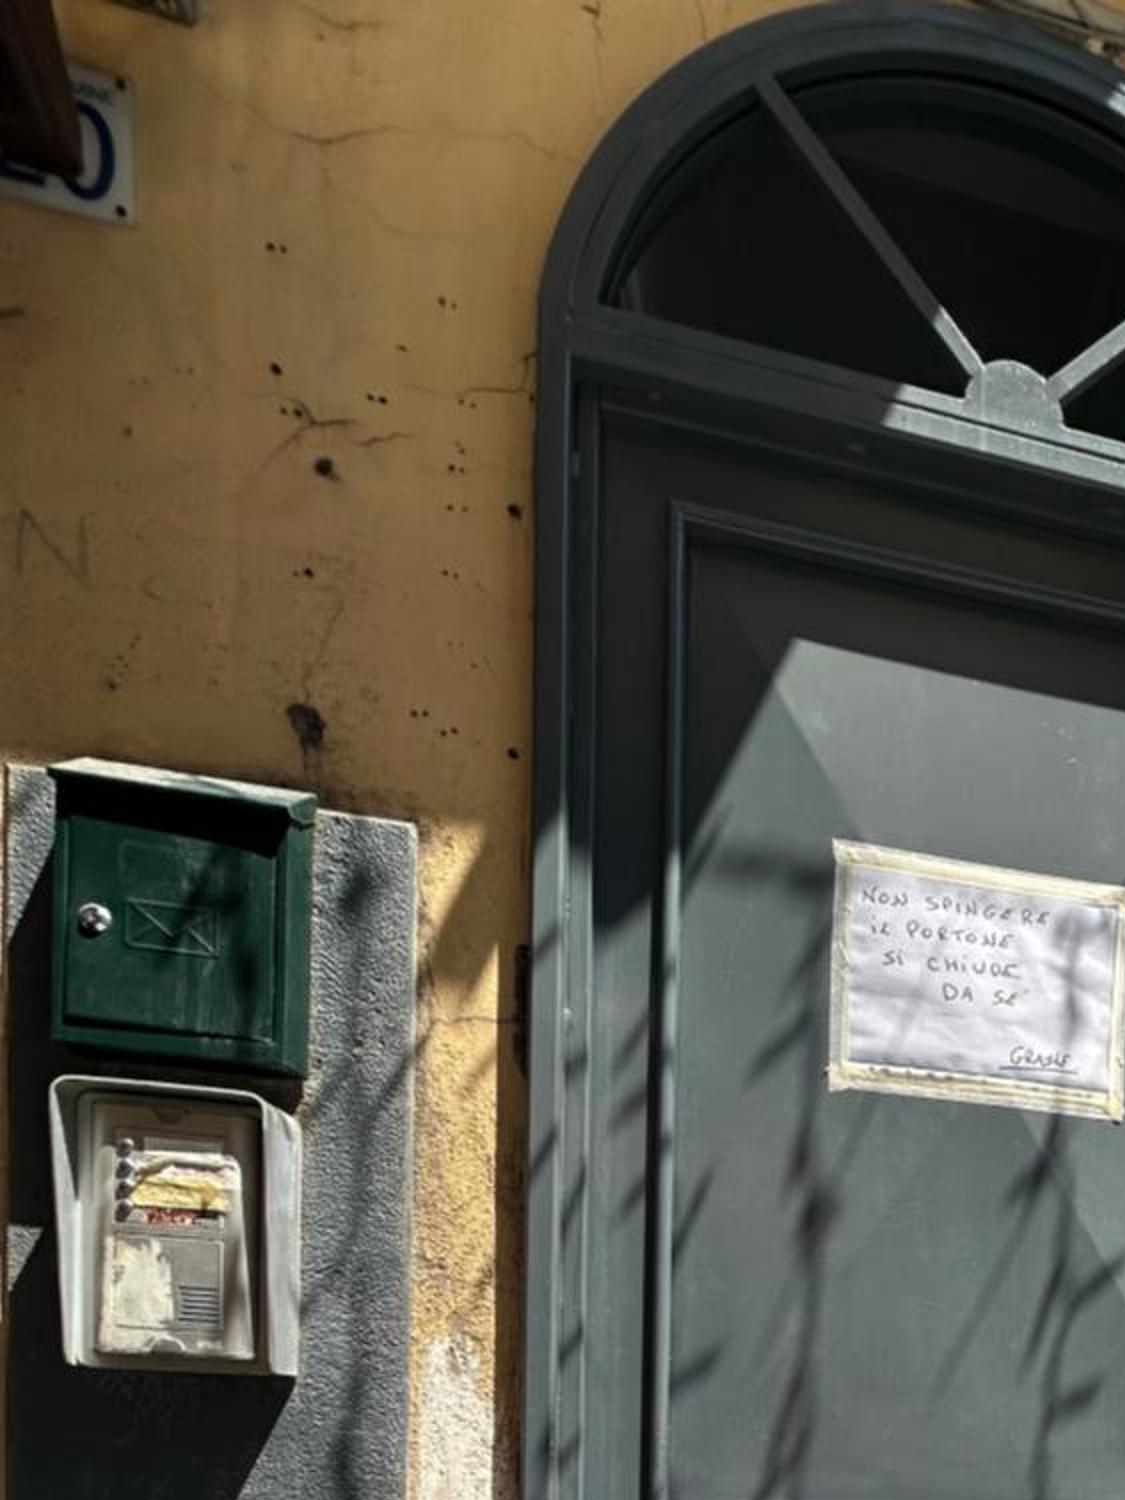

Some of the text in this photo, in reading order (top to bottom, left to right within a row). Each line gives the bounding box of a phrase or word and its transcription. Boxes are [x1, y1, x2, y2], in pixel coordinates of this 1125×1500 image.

[862, 885, 909, 908] NON
[905, 919, 1015, 949] PORTONE
[942, 982, 974, 1003] DA
